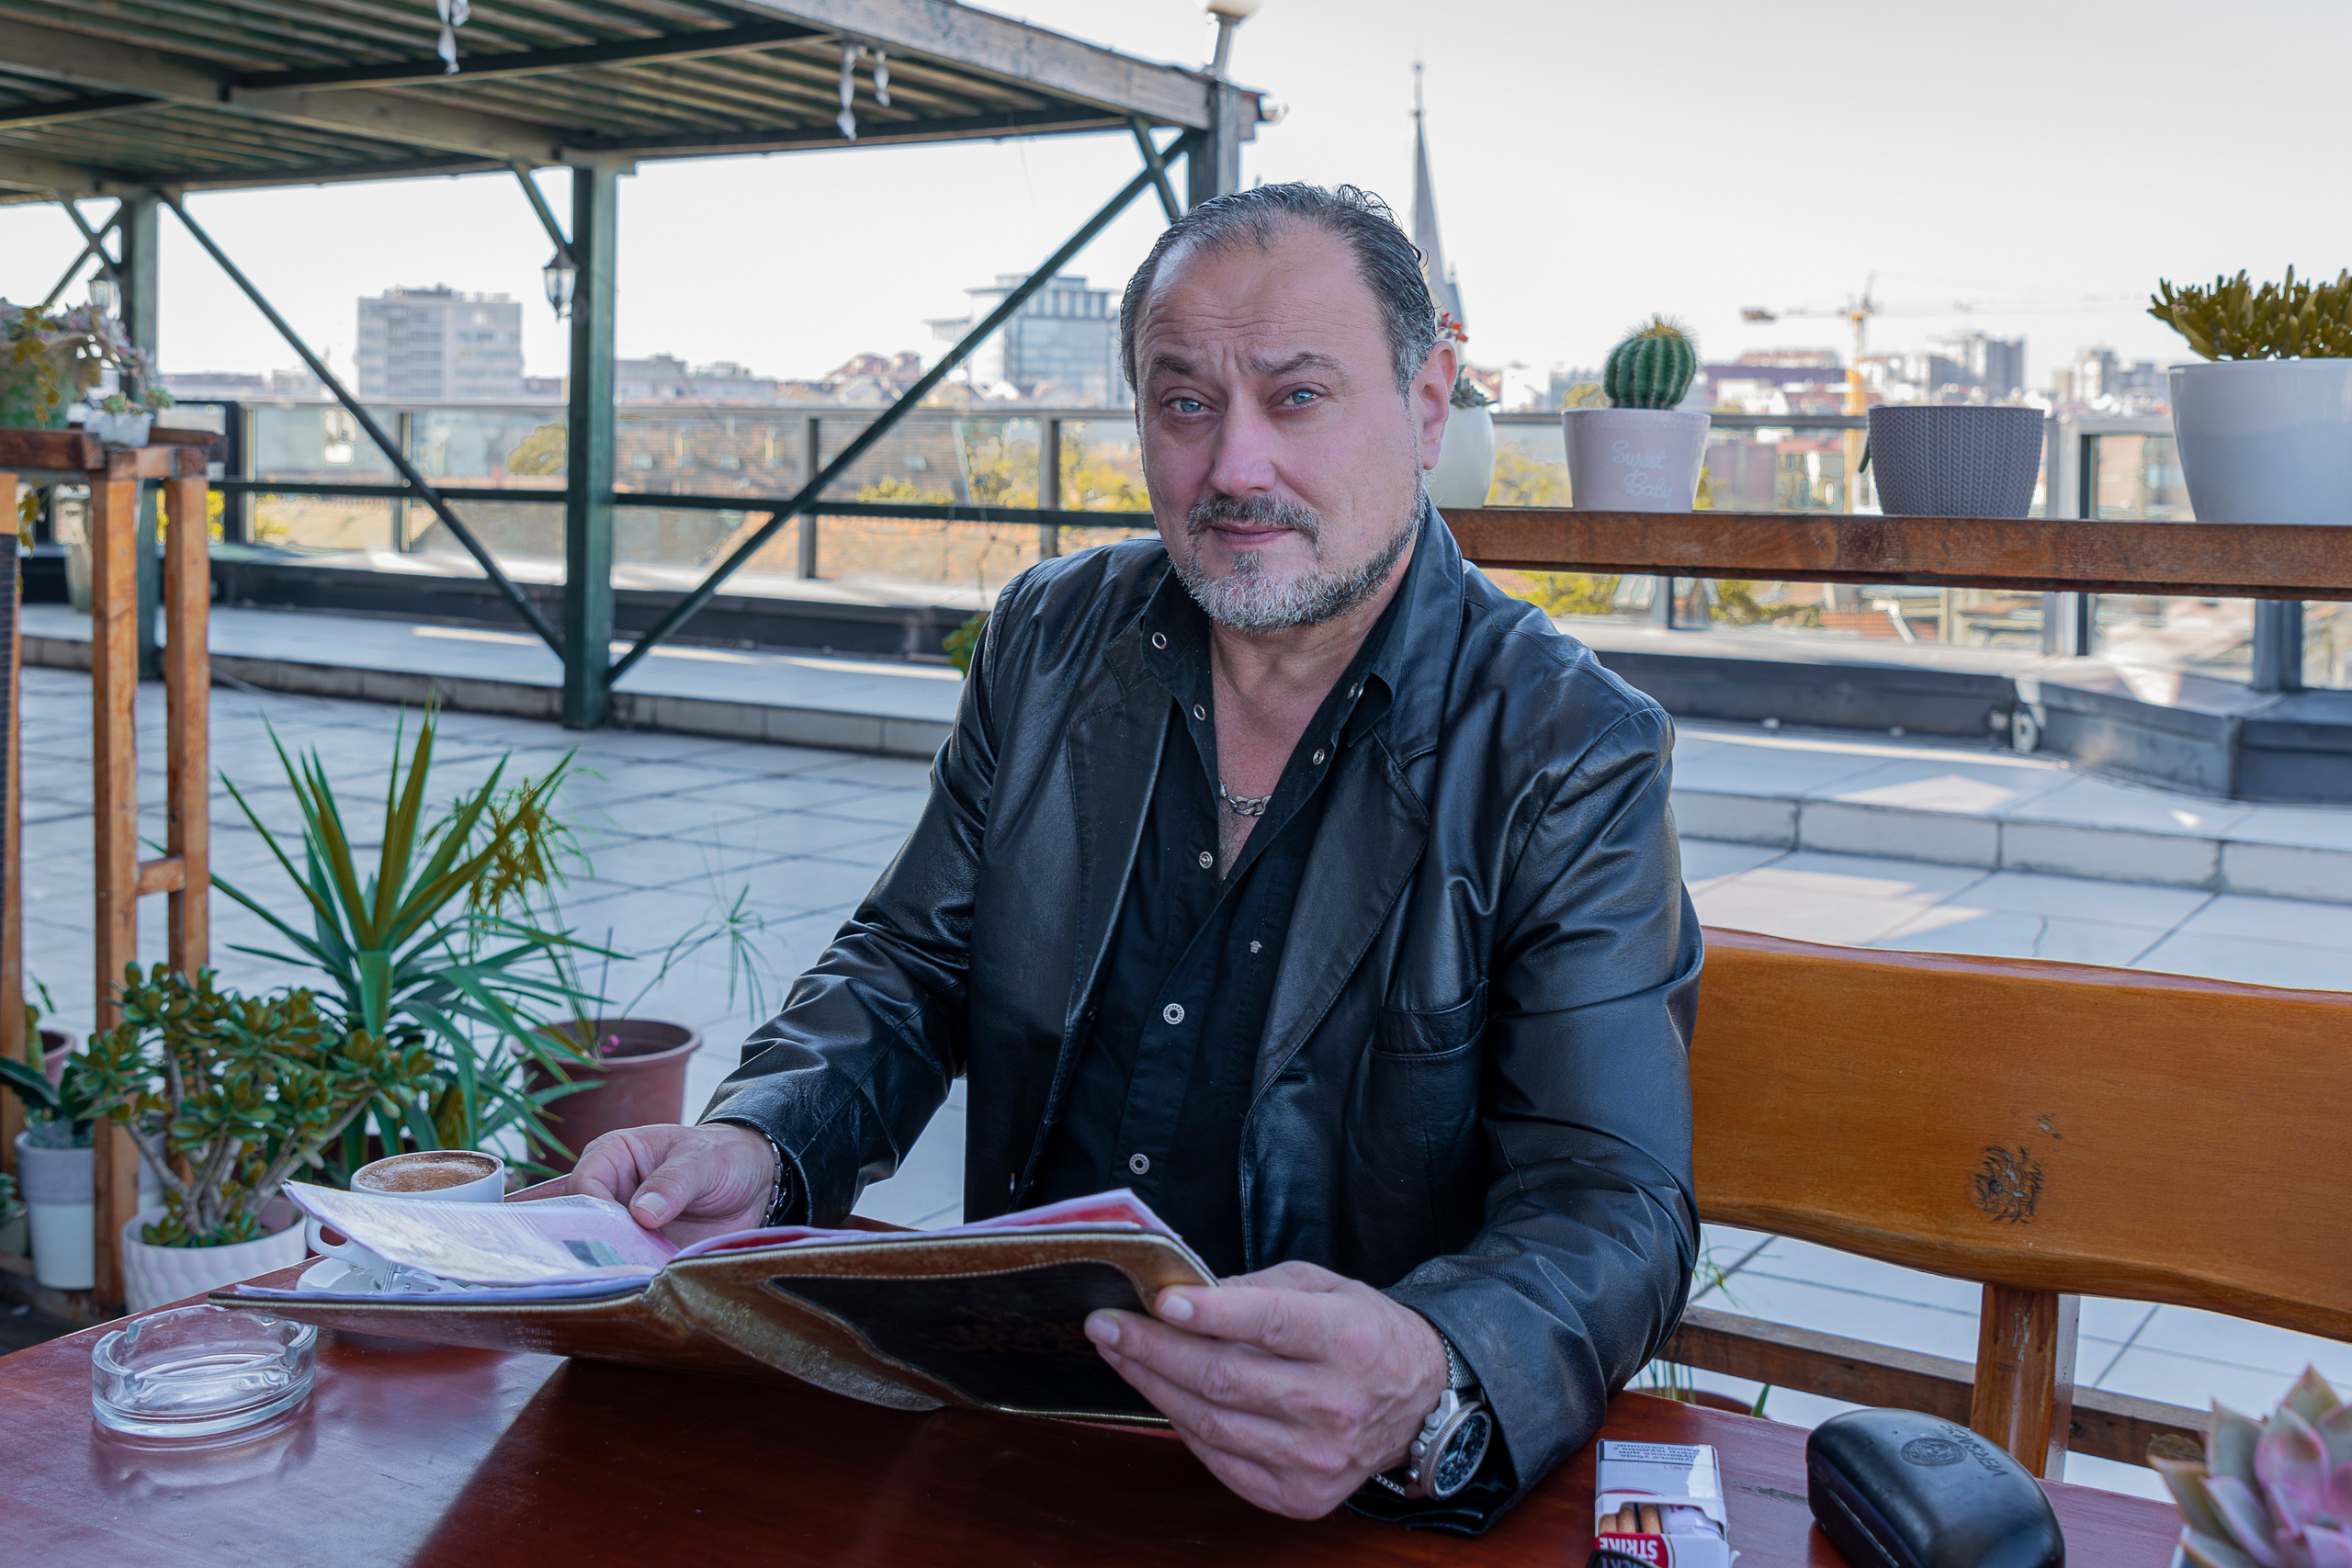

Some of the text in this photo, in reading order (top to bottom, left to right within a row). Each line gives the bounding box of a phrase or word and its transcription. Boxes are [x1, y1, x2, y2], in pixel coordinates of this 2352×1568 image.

[1611, 440, 1668, 470] Sweet
[1623, 470, 1673, 508] Baby
[1939, 1425, 2008, 1476] VERSACE
[1599, 1537, 1658, 1560] STRIKE
